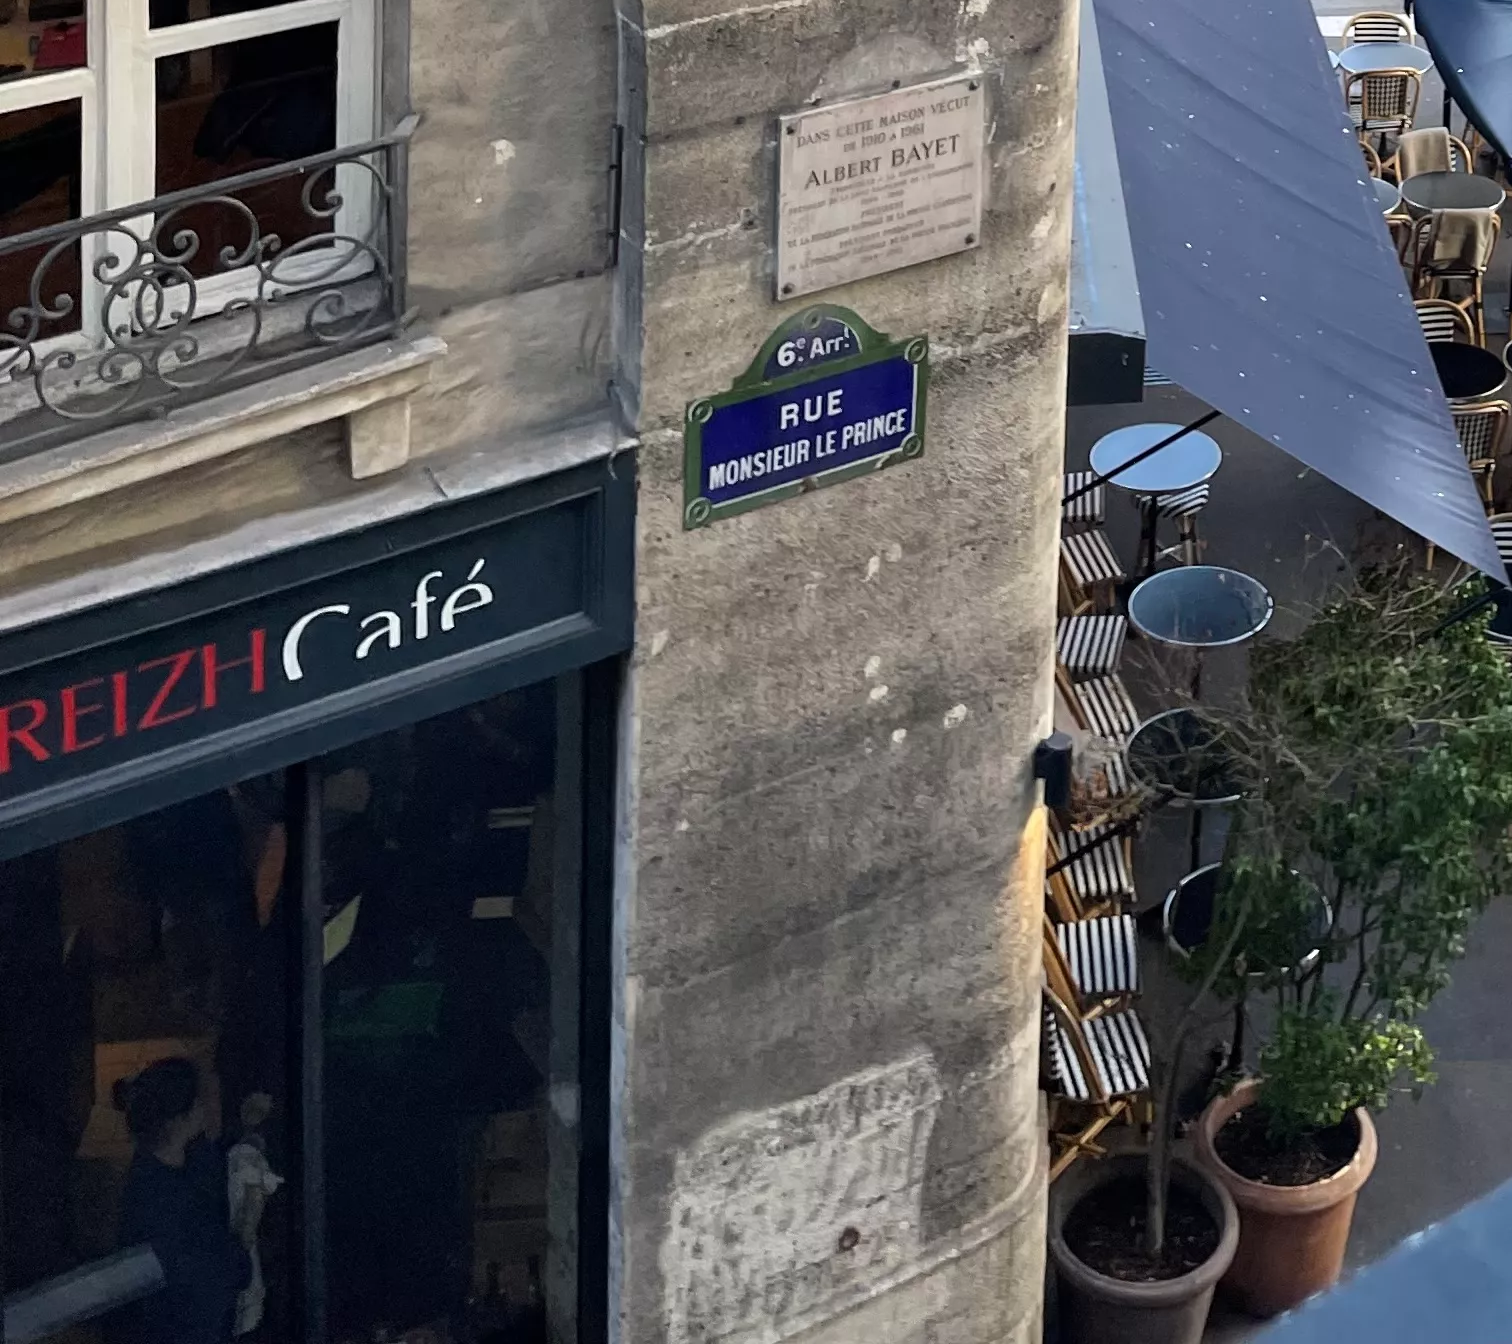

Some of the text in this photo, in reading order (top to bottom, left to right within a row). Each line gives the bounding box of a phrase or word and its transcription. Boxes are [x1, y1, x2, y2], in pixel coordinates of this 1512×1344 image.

[797, 129, 830, 148] DANS
[836, 119, 874, 138] CETTE
[879, 106, 925, 128] MAISON
[804, 156, 883, 190] ALBERT
[891, 134, 961, 167] BAYET
[780, 389, 844, 430] RUE
[709, 408, 907, 490] MONSIEUR LE PRINCE
[282, 558, 494, 681] Café
